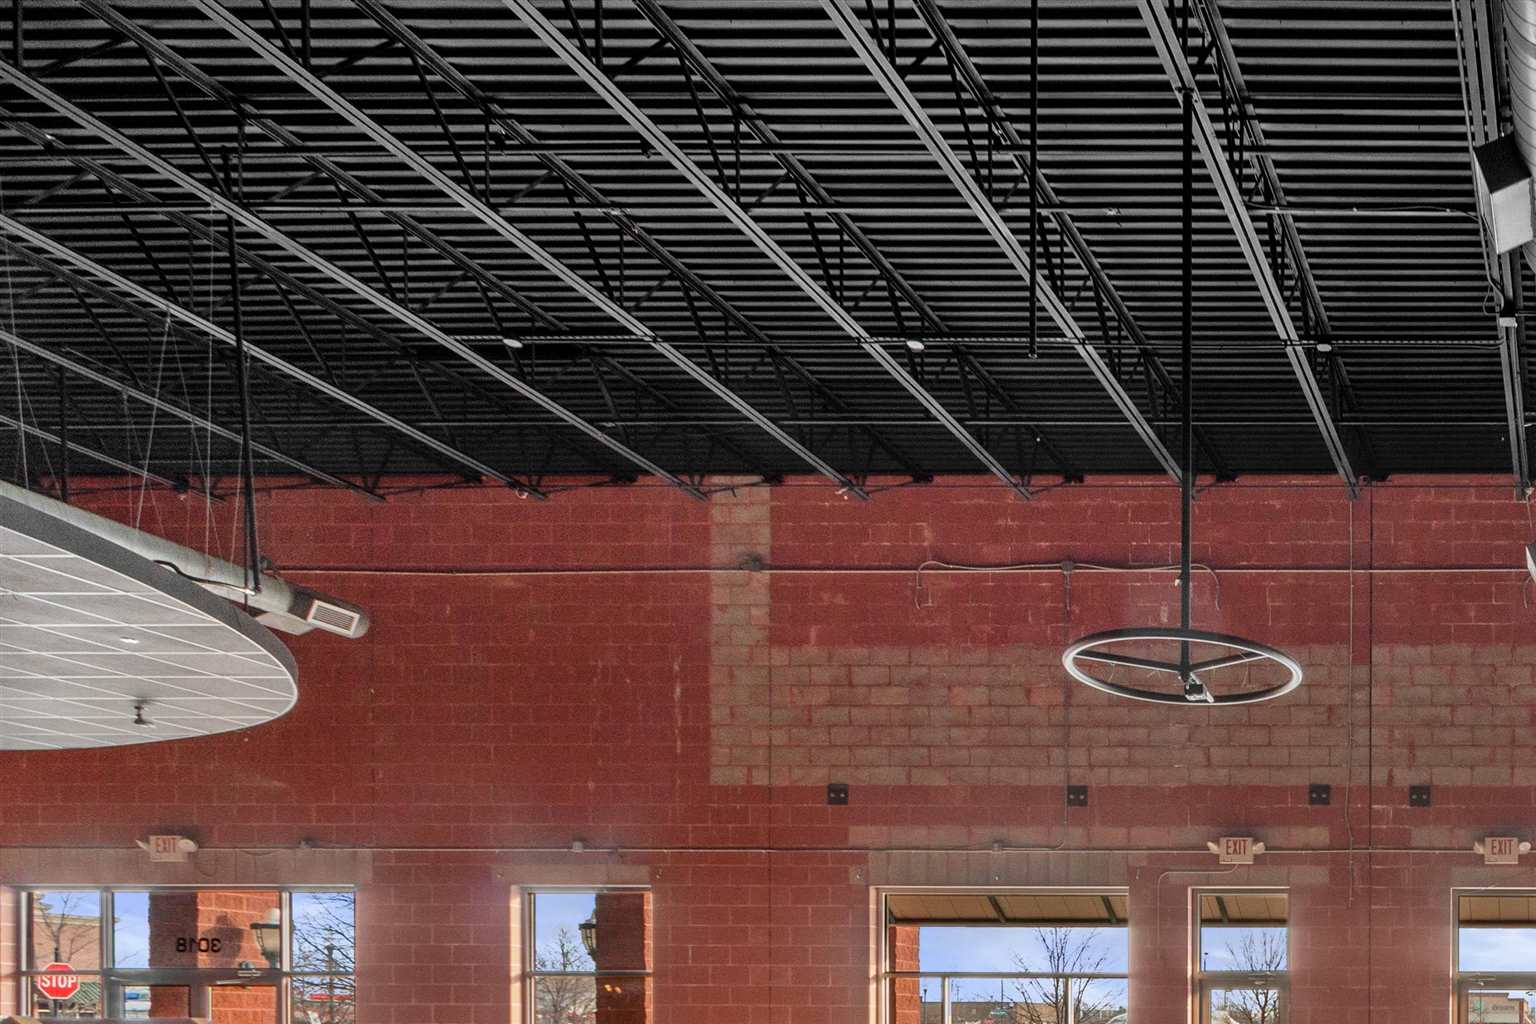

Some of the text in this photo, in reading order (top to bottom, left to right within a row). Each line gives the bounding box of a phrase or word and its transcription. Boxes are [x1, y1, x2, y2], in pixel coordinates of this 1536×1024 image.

[155, 838, 177, 854] EXIT
[1226, 839, 1248, 856] EXIT
[1491, 839, 1513, 855] EXIT
[41, 974, 77, 988] STOP
